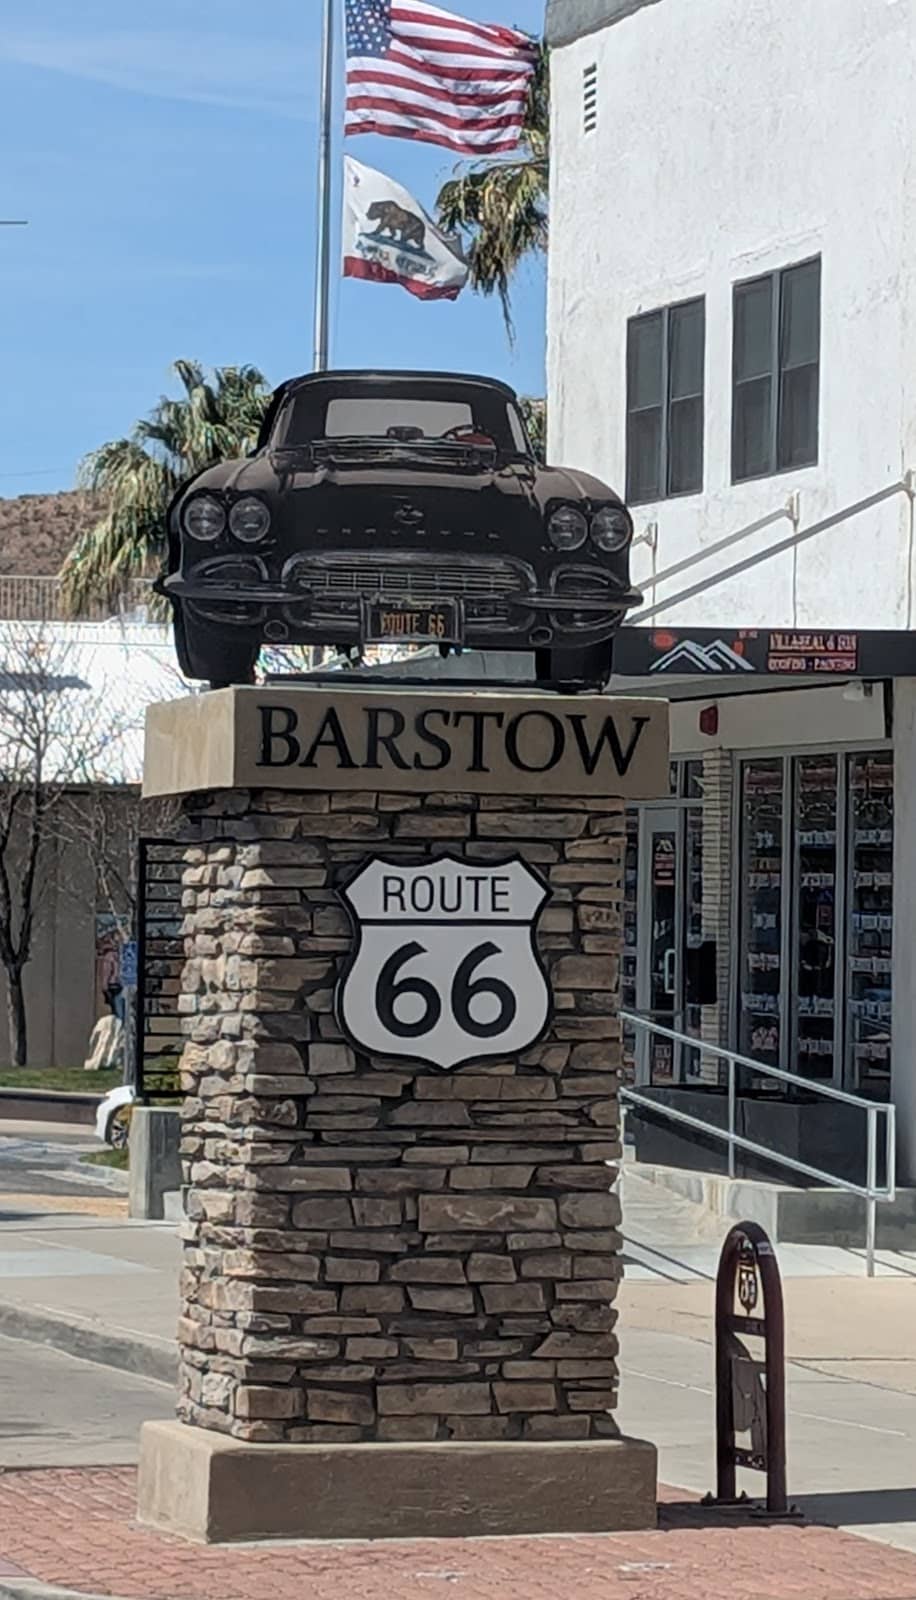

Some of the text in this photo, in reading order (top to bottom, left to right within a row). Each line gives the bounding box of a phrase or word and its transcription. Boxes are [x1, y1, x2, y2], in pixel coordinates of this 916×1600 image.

[380, 612, 445, 637] ROUTE 66
[256, 706, 651, 777] BARSTOW
[383, 875, 510, 912] ROUTE
[375, 941, 517, 1038] 66
